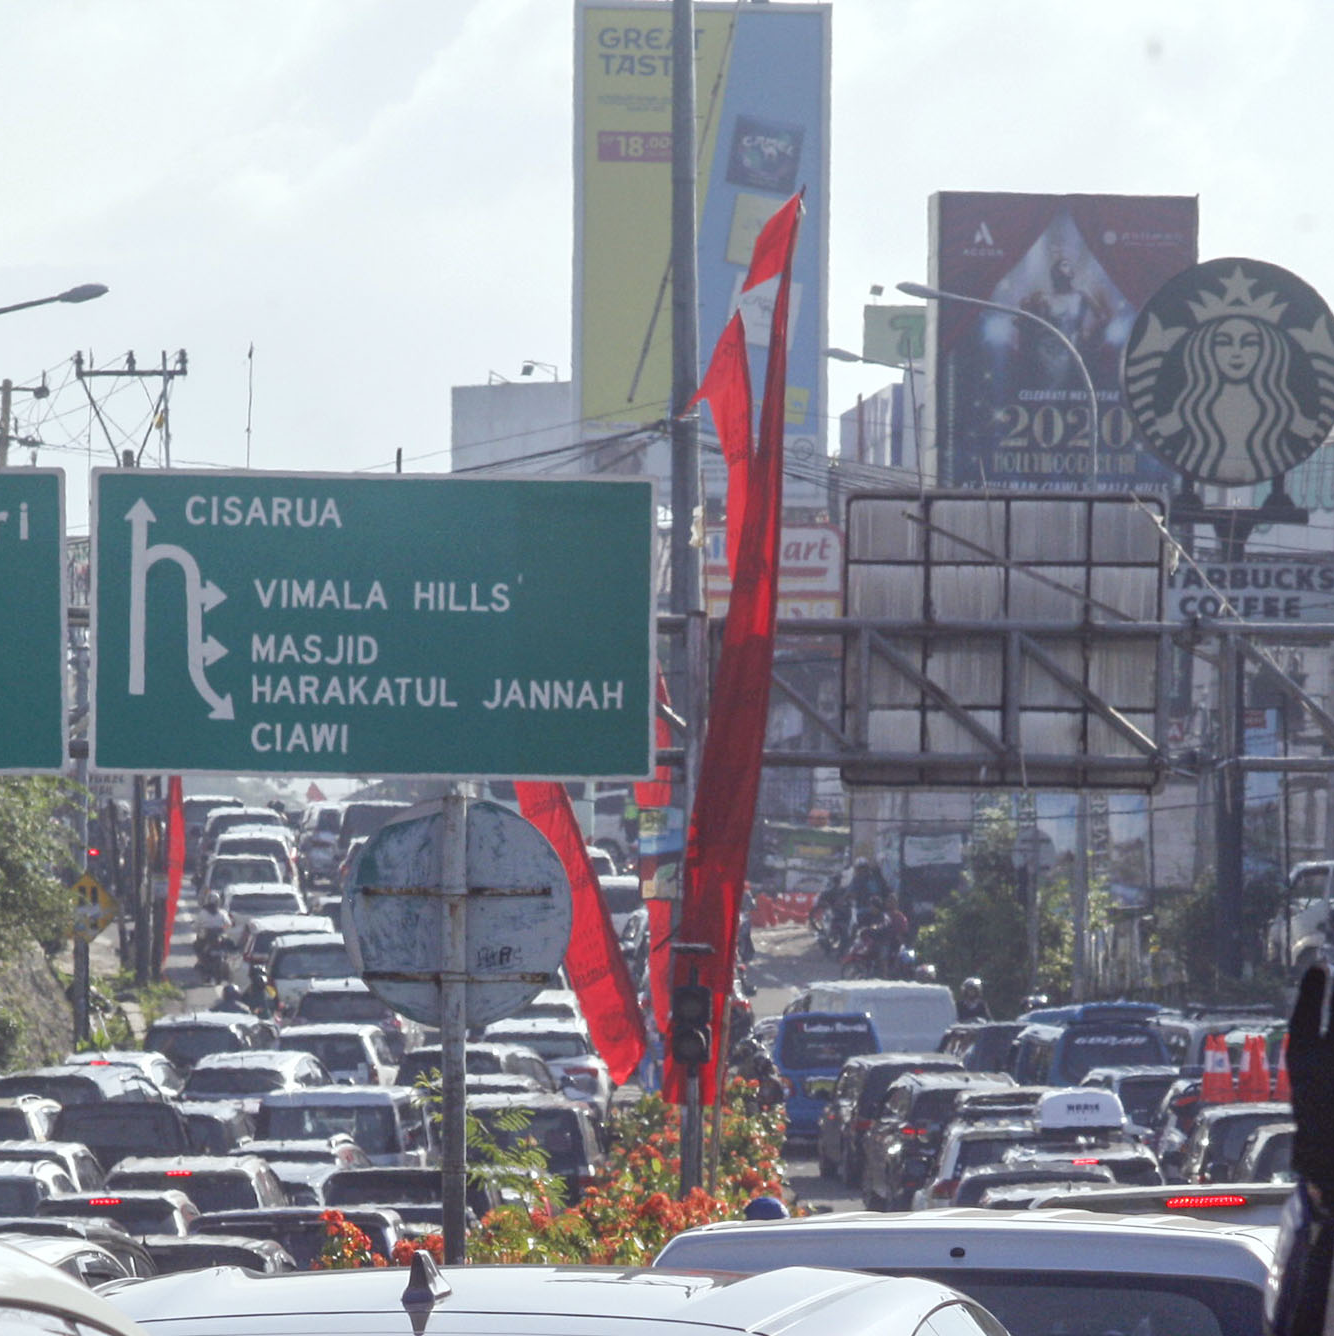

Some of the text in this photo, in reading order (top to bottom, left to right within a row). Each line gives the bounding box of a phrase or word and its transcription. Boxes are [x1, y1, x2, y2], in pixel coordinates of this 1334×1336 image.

[597, 26, 705, 51] GRET
[598, 53, 703, 77] TAST
[617, 136, 673, 157] 18.00
[998, 404, 1133, 449] 2020
[185, 494, 342, 528] CISARUA
[254, 578, 388, 612] VIMALA
[1178, 595, 1301, 619] COFFEE
[252, 633, 379, 664] MASJID
[251, 675, 625, 712] HARAKATUL JANNAH
[251, 722, 350, 755] CIAWI
